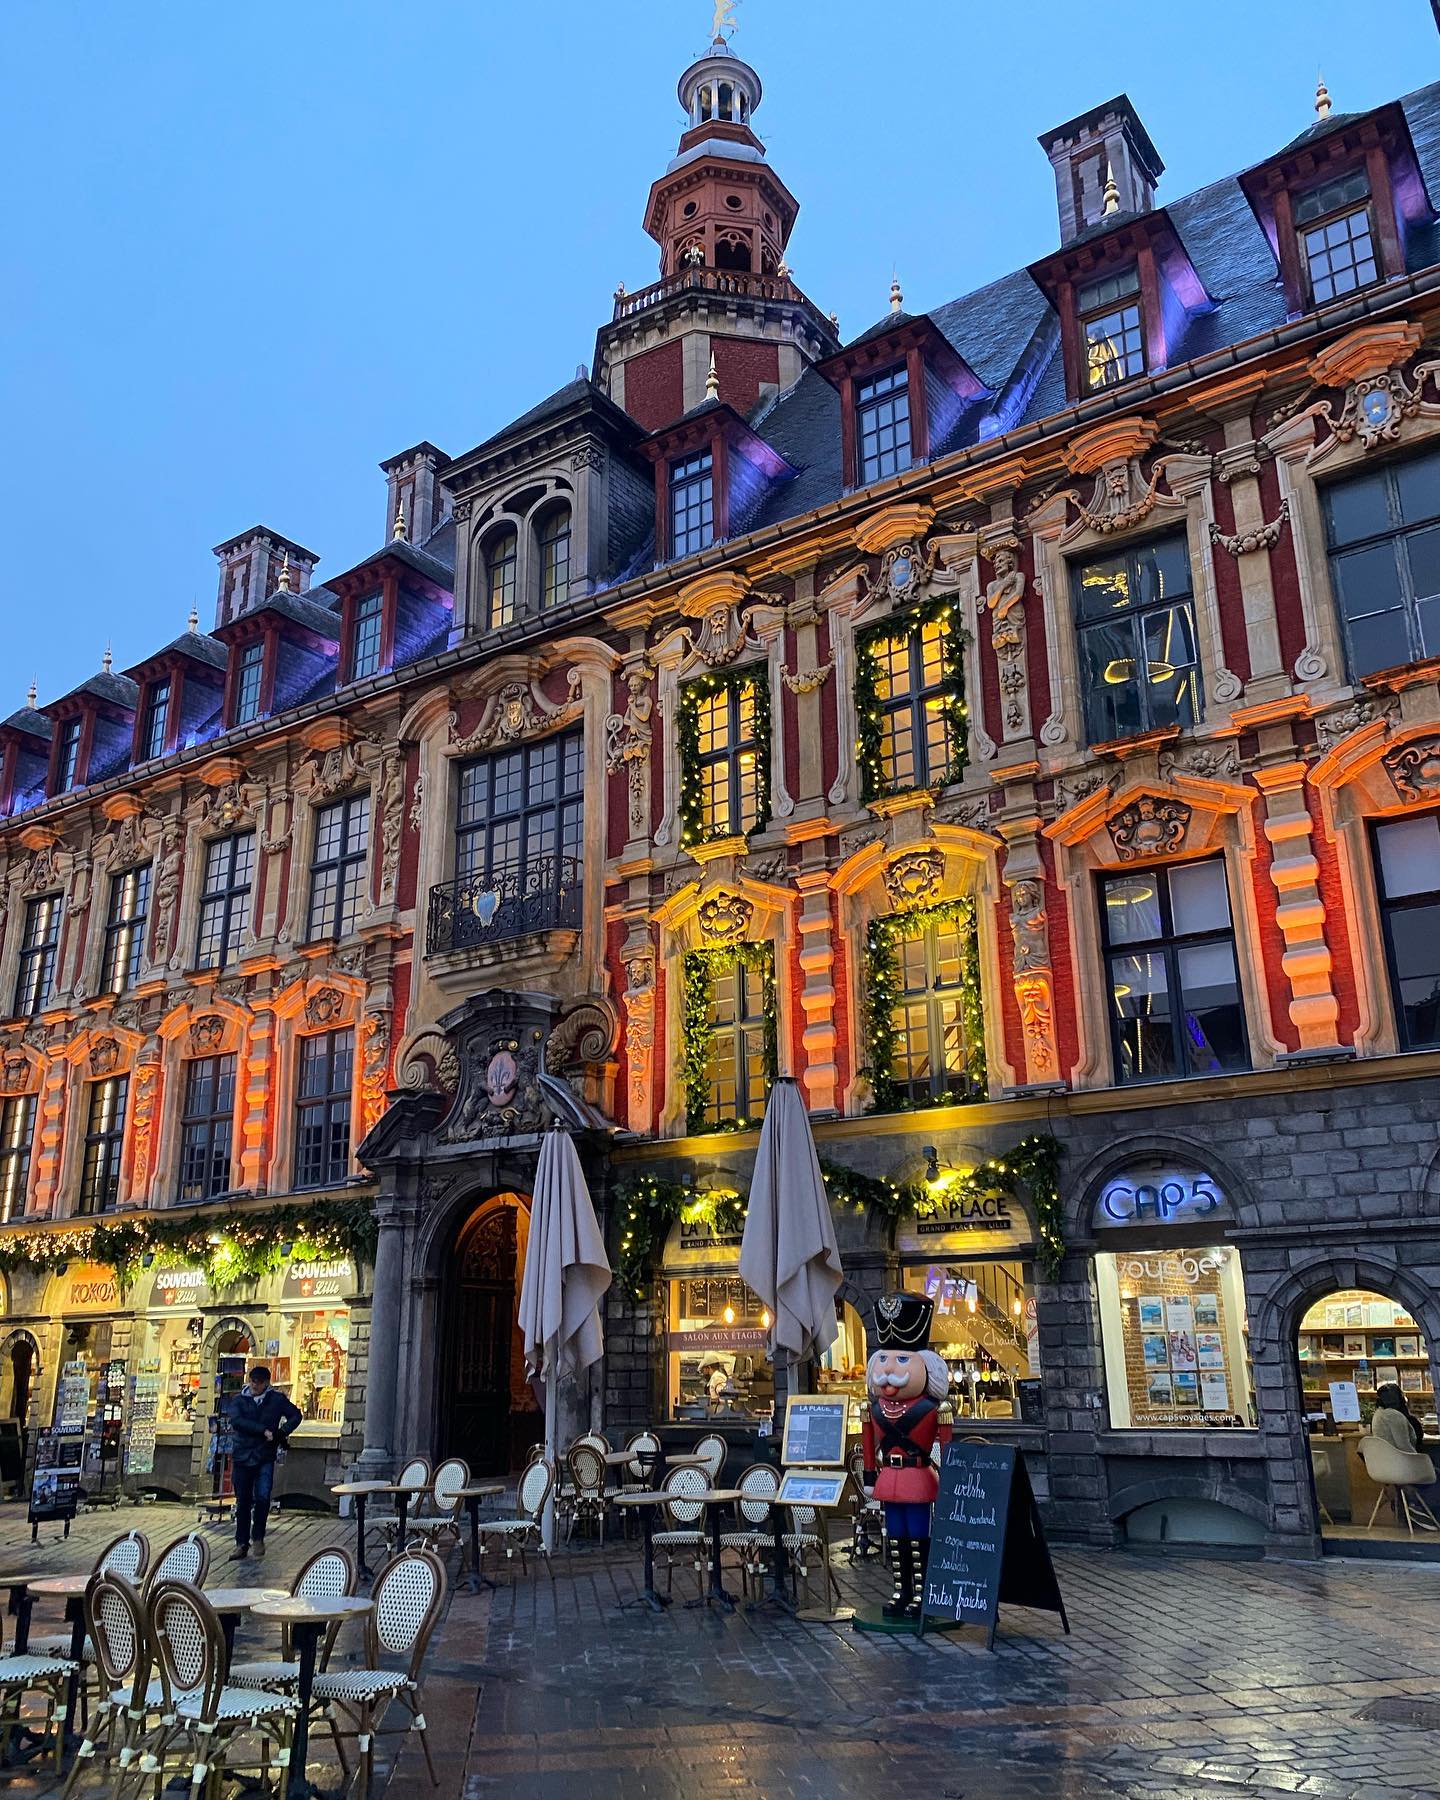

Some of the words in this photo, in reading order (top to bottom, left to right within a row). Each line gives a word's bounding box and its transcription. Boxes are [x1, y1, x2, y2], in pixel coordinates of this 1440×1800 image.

[916, 1199, 939, 1220] LA
[949, 1196, 1011, 1218] PLACE
[919, 1223, 946, 1233] GRAND
[950, 1222, 975, 1231] PLACE
[987, 1221, 1008, 1229] LILLE
[290, 1259, 352, 1280] SOUVENIRS
[156, 1270, 208, 1290] SOUVENIRS
[313, 1280, 340, 1296] Lille
[175, 1289, 198, 1304] Lille
[683, 1332, 710, 1342] SALON
[711, 1332, 729, 1341] AUX
[1135, 1412, 1235, 1423] www.cap5voyages.com
[51, 1425, 82, 1435] SOUVENIRS
[928, 1583, 953, 1607] Frites
